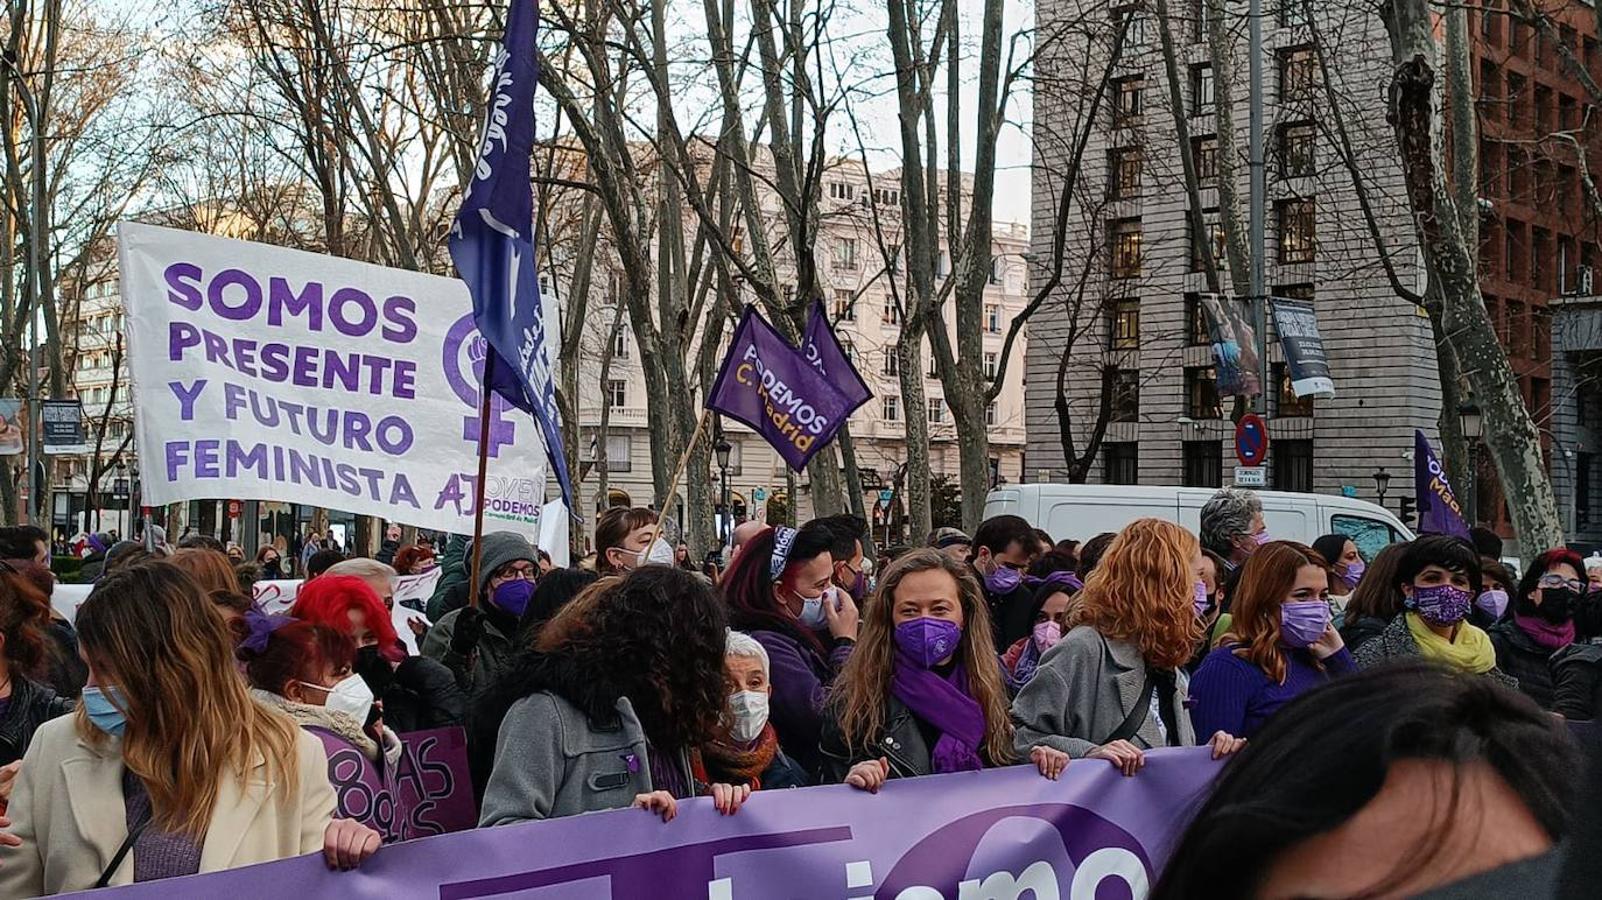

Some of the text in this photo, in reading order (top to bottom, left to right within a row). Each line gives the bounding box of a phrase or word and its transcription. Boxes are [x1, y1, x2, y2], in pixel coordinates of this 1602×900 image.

[164, 263, 418, 344] SOMOS
[169, 322, 416, 399] PRESENTE
[743, 345, 828, 434] PODEMOS
[168, 379, 414, 456] Y FUTURO
[757, 384, 816, 453] Madrid
[165, 439, 421, 509] FEMINISTA
[484, 499, 540, 517] PODEMOS
